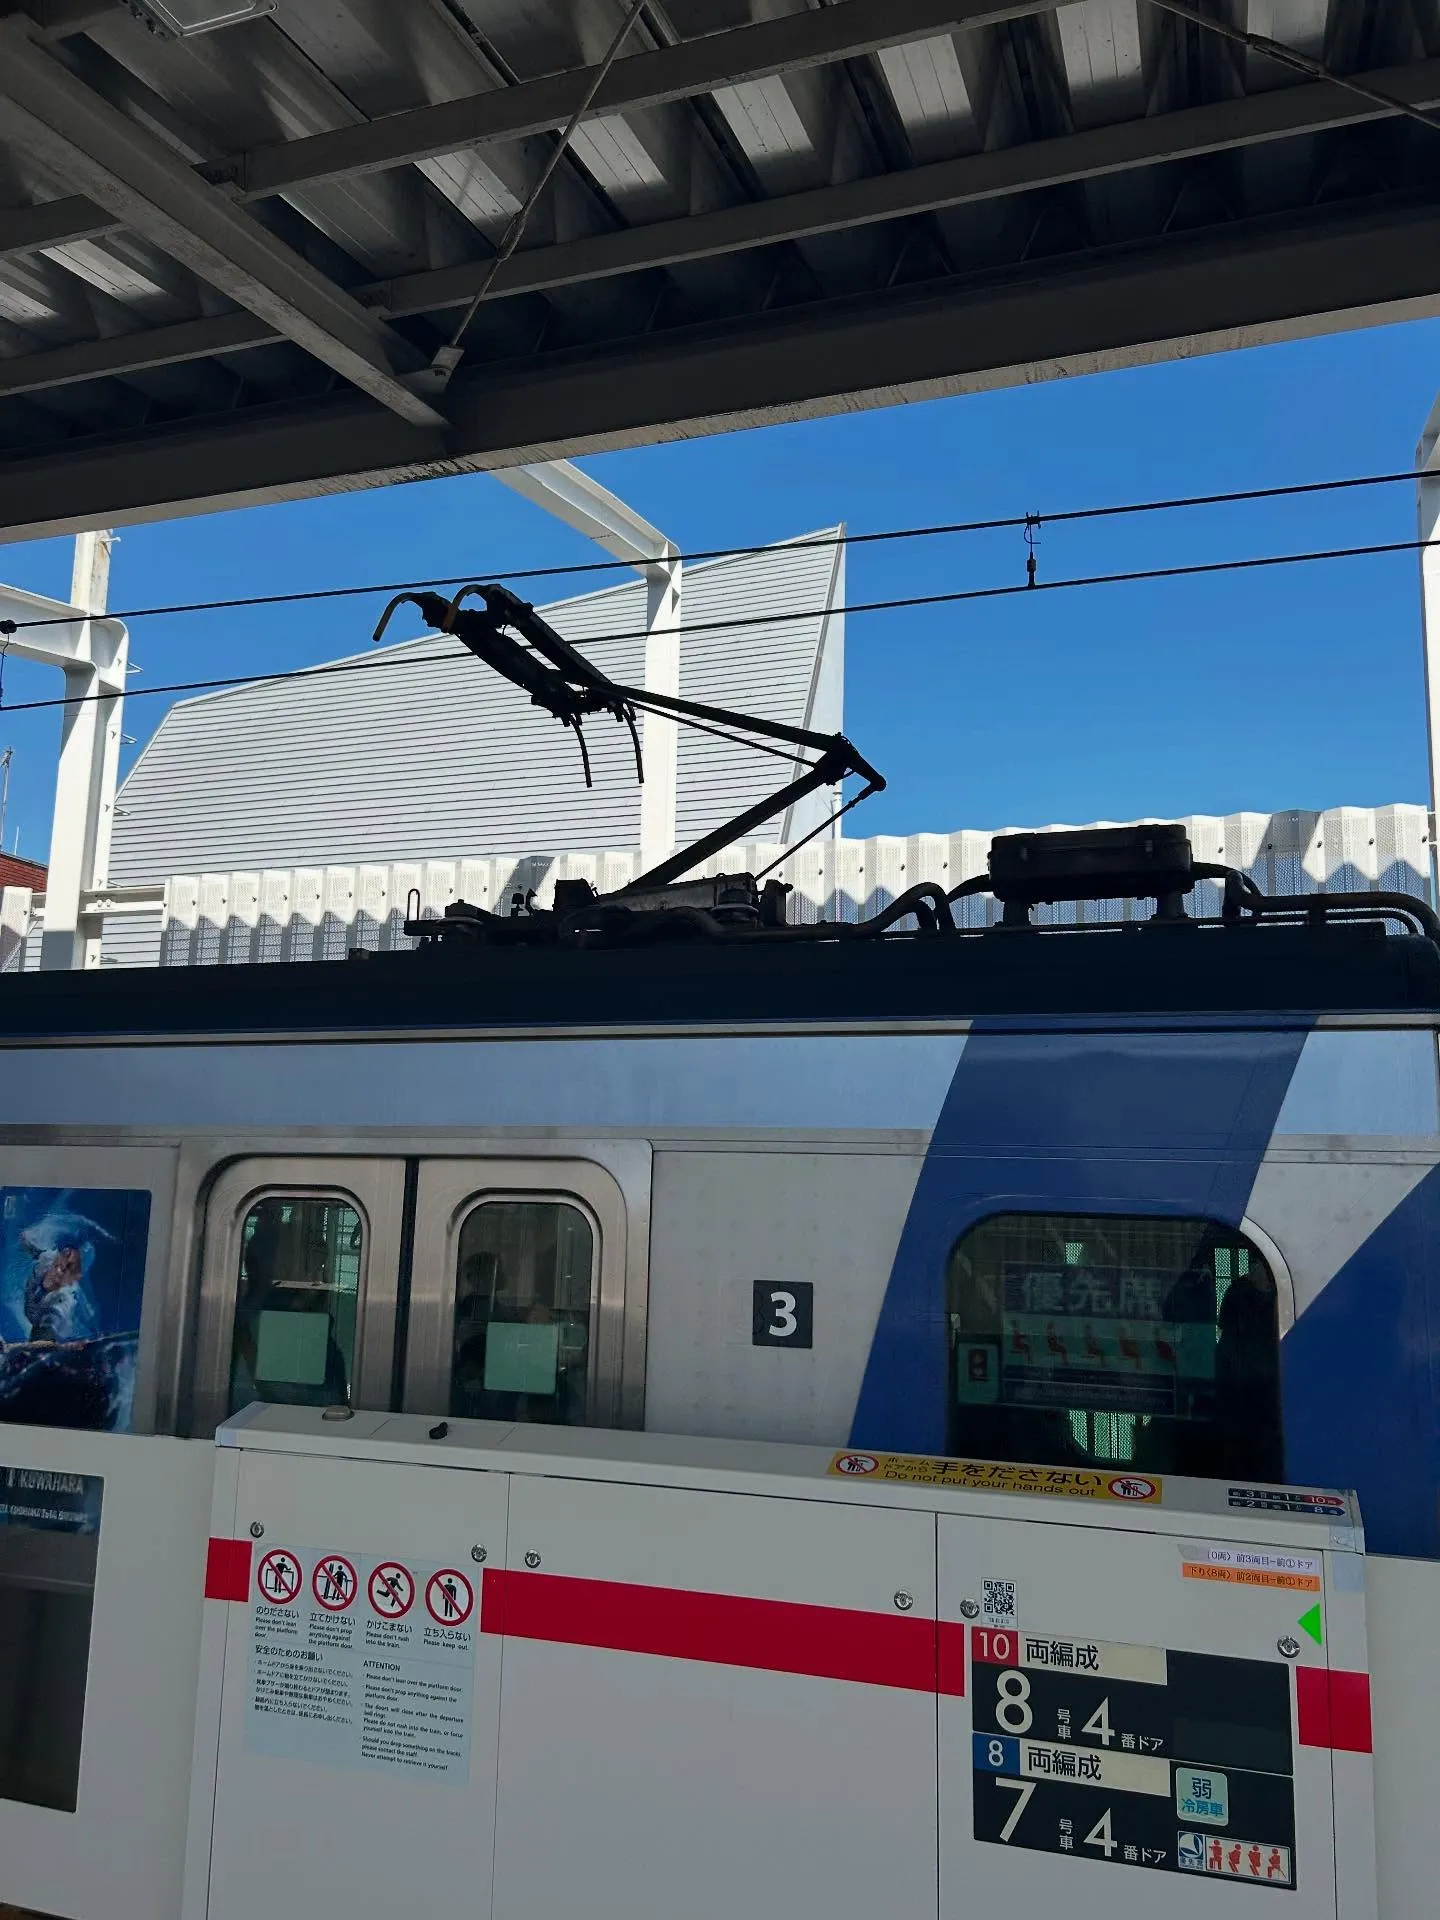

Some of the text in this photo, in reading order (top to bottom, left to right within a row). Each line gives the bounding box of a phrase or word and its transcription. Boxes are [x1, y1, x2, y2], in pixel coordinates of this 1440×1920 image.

[769, 1291, 797, 1337] 3
[888, 1457, 929, 1465] ホーム
[932, 1461, 1103, 1486] 手をださない
[884, 1471, 1095, 1496] Do not put your hands out
[256, 1606, 299, 1618] のりださない
[310, 1613, 356, 1625] 立てかけない
[367, 1620, 412, 1633] かけこまない
[424, 1627, 470, 1641] 立ち入らない
[443, 1641, 455, 1649] keep
[979, 1632, 1099, 1671] 10 両編成
[255, 1645, 323, 1661] 安全のためのお願い
[363, 1660, 400, 1671] ATTENTION
[408, 1691, 429, 1699] anything
[995, 1669, 1163, 1751] 8 号車 4 番ドア
[440, 1715, 463, 1723] departure
[403, 1743, 428, 1752] something
[377, 1754, 395, 1762] attempt
[988, 1740, 1102, 1781] 8 両編成
[1192, 1777, 1211, 1799] 弱
[1181, 1798, 1224, 1817] 冷房車
[995, 1776, 1166, 1863] 7 号車 4 番ドア
